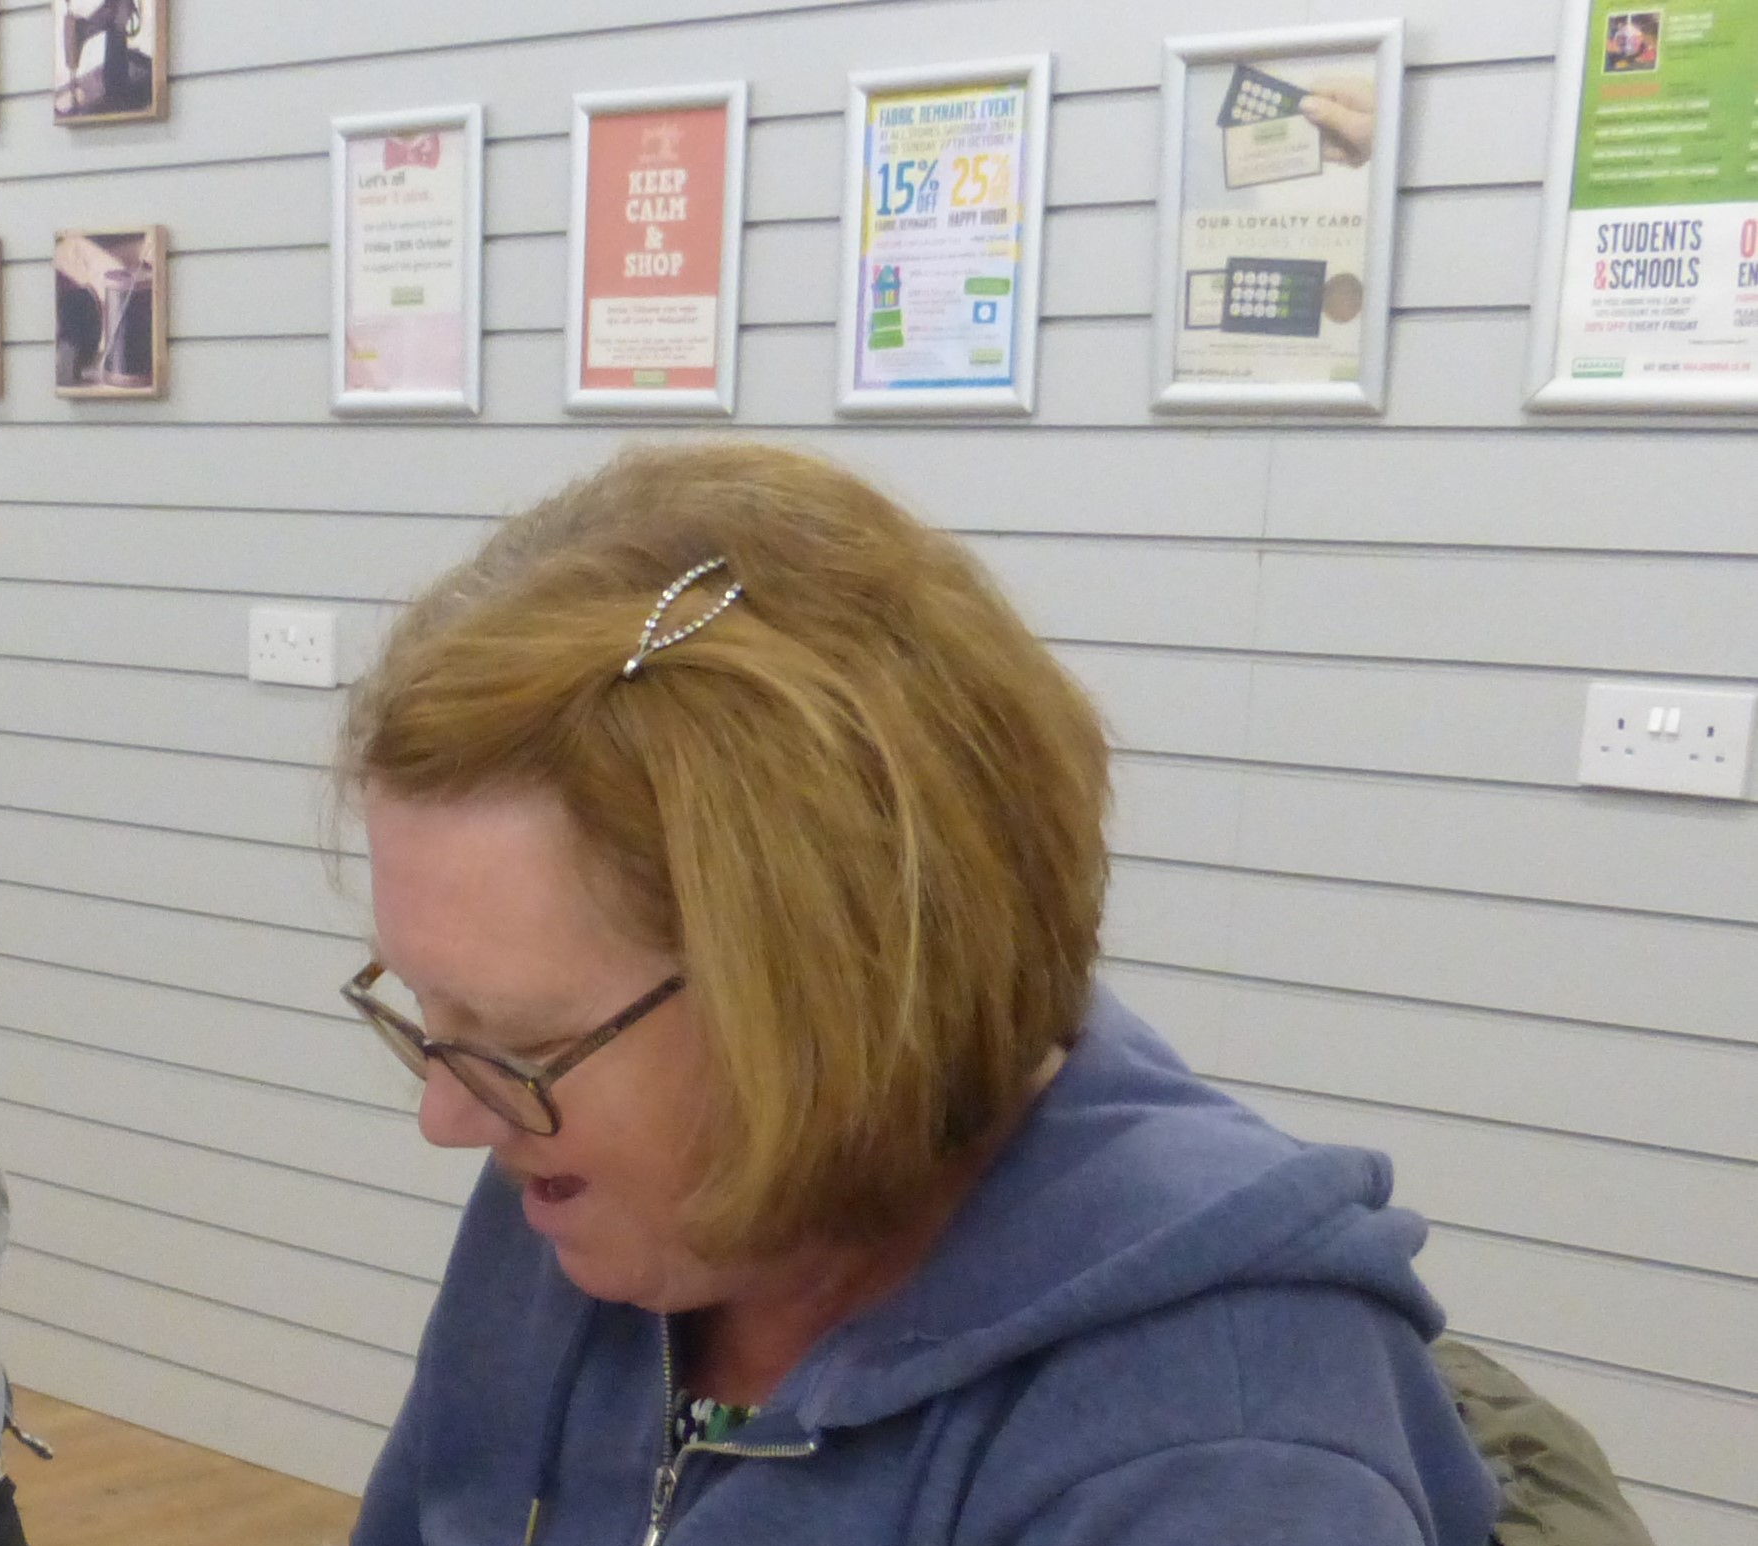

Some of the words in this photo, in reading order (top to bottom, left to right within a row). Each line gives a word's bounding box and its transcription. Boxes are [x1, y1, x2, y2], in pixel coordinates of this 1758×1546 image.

[919, 101, 976, 123] REMNANTS
[980, 95, 1016, 118] EVENT
[628, 168, 688, 196] KEEP
[626, 195, 687, 223] CALM
[916, 193, 938, 213] OFF
[948, 211, 977, 227] HAPPY
[980, 208, 1007, 225] HOUR
[1196, 216, 1230, 229] OUR
[1238, 215, 1310, 229] LOYALTY
[1317, 214, 1362, 228] CARD
[645, 223, 664, 249] &
[1597, 220, 1703, 254] STUDENTS
[624, 252, 684, 278] SHOP
